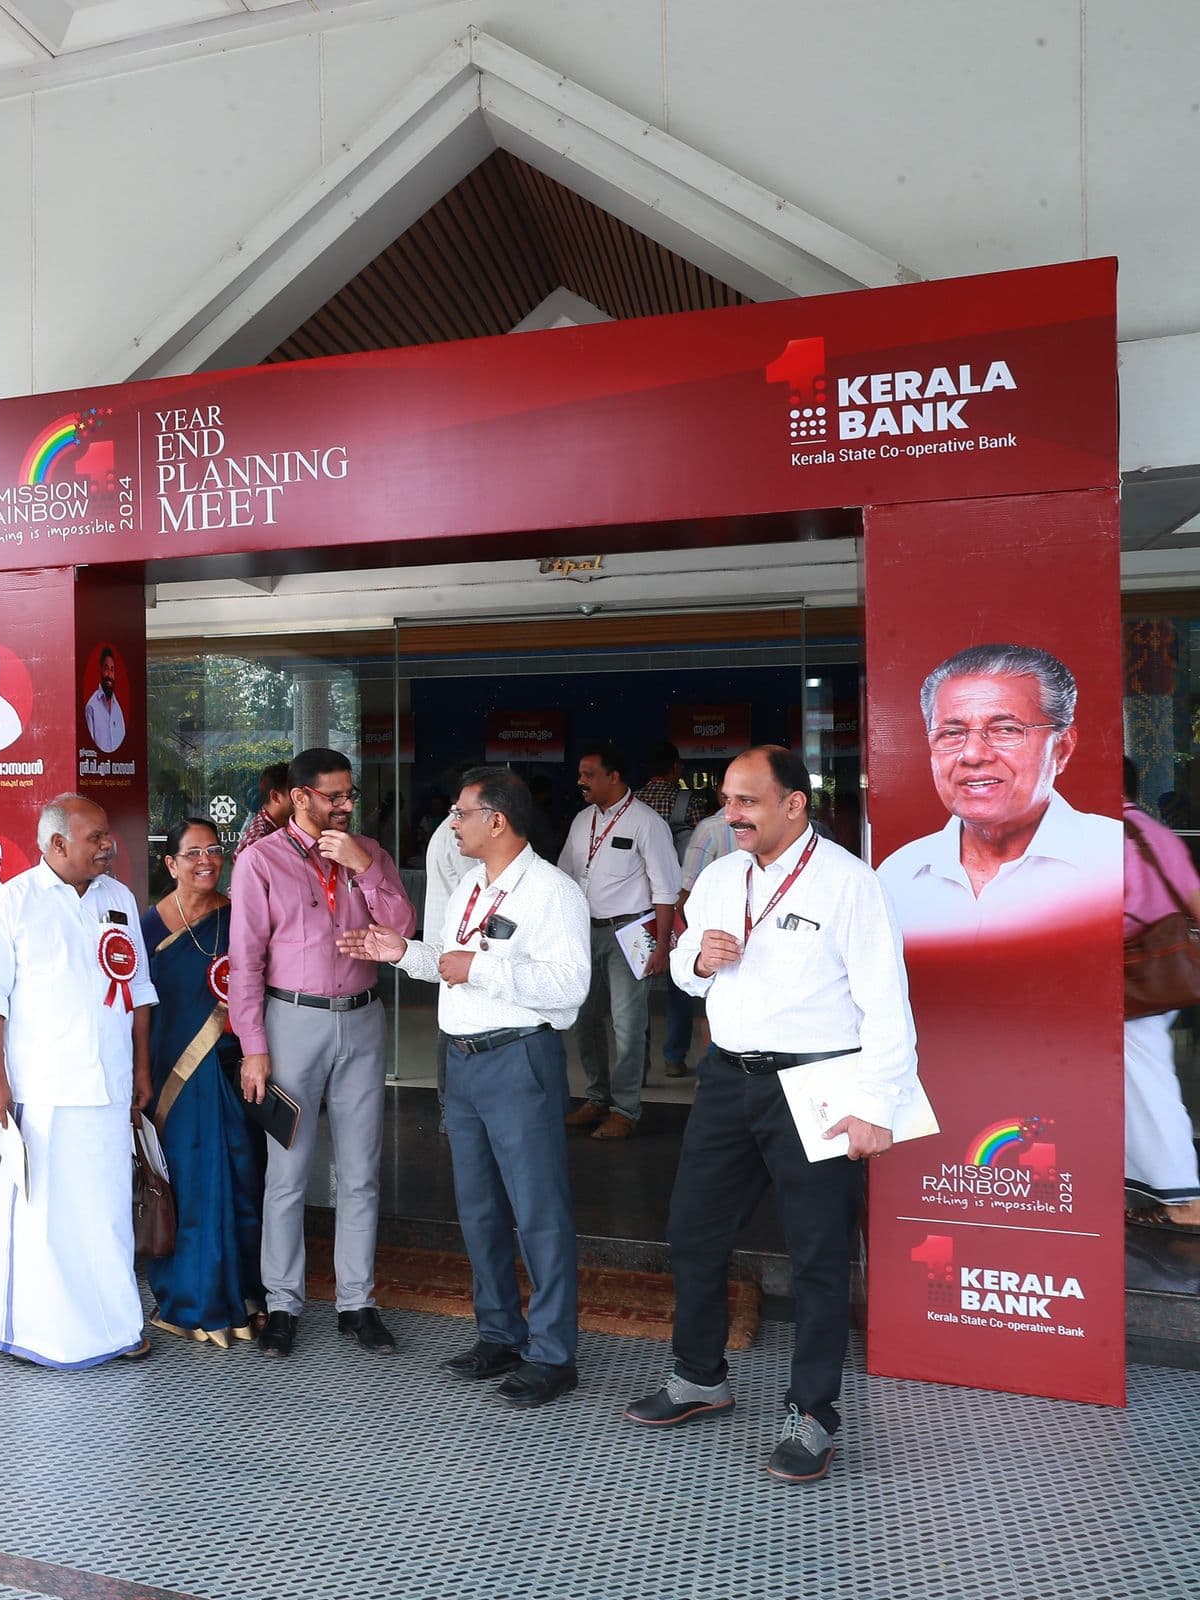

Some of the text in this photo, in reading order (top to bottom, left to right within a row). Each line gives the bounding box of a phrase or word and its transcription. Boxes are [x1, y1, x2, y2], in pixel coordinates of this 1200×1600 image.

[837, 361, 1018, 407] KERALA
[155, 405, 224, 432] YEAR
[838, 399, 969, 440] BANK
[156, 428, 225, 462] END
[791, 433, 1017, 466] Kerala State Co-operative Bank
[156, 446, 349, 495] PLANNING
[119, 475, 133, 530] 2024
[157, 486, 284, 534] MEET
[30, 526, 40, 539] is
[47, 519, 116, 542] impossible
[922, 1176, 1031, 1197] RAINBOW
[941, 1164, 1030, 1183] MISSION
[921, 1192, 1057, 1214] nothing is impossible
[1059, 1172, 1073, 1213] 2024
[960, 1267, 1085, 1299] KERALA
[960, 1290, 1052, 1319] BANK
[927, 1311, 1086, 1338] Kerala State Co-operative Bank
